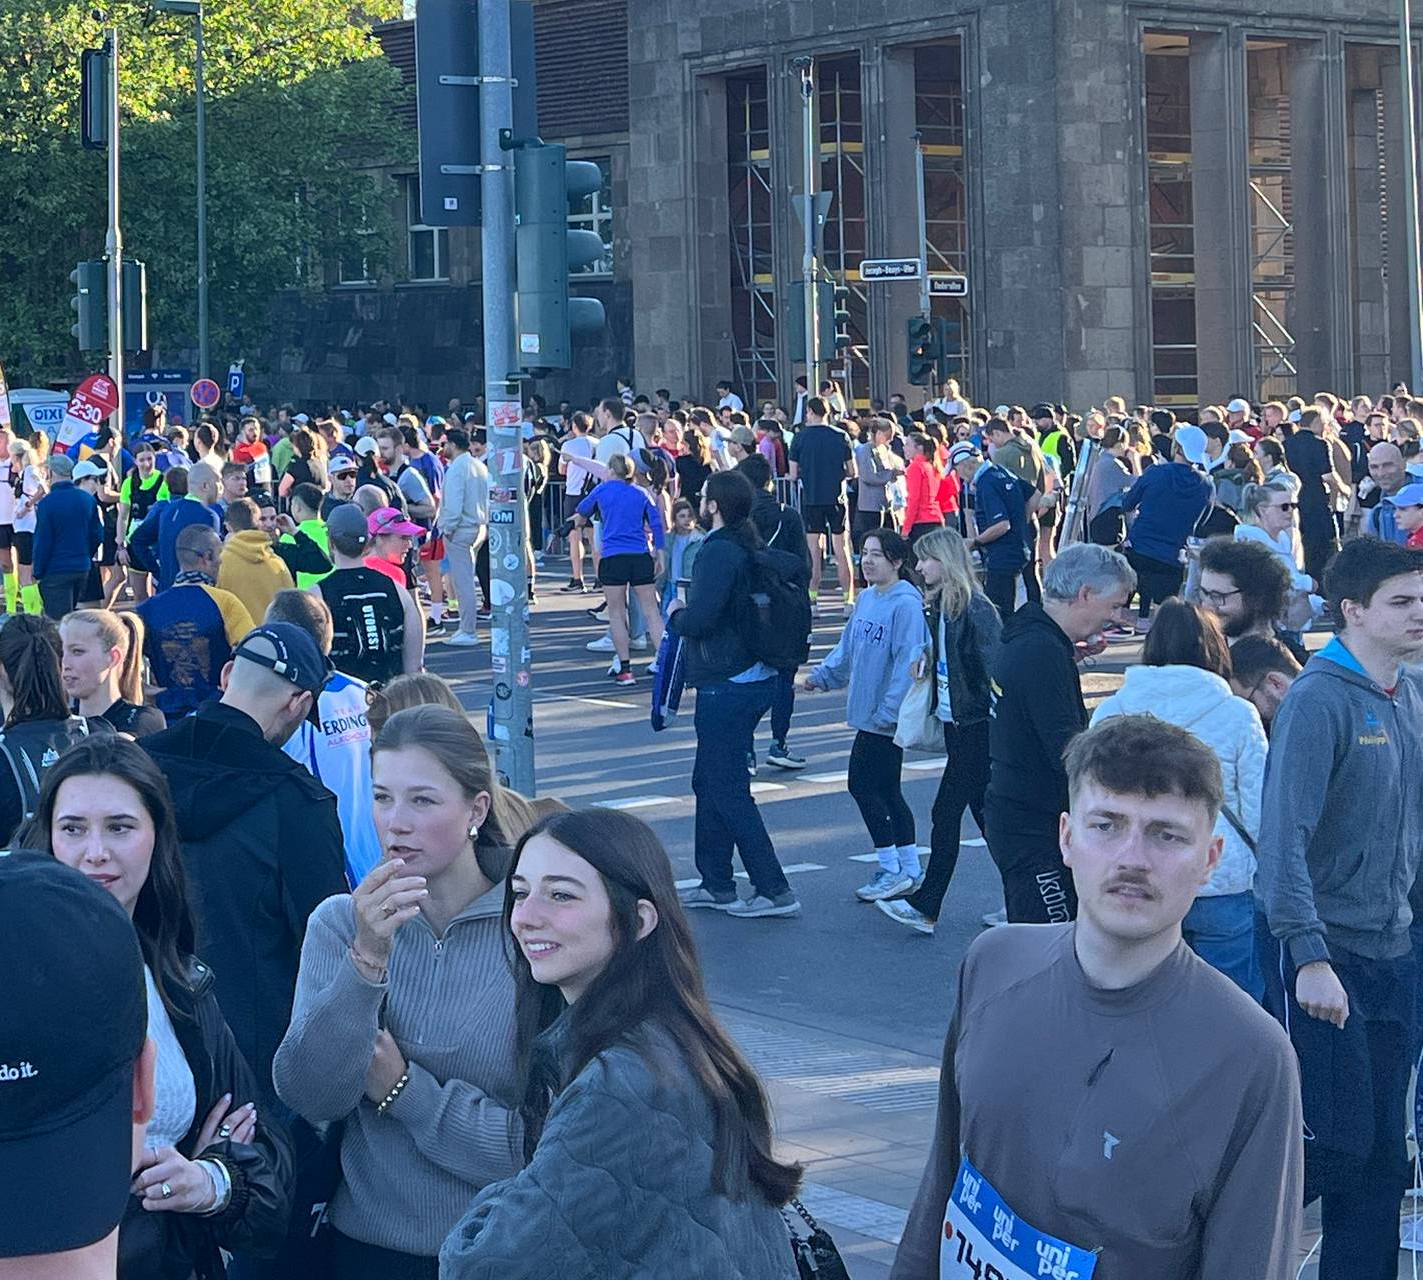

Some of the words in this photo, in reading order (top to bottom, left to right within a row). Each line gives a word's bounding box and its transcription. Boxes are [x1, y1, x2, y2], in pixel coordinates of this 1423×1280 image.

[34, 408, 63, 421] DIXI
[68, 398, 103, 424] 2:30
[361, 604, 380, 651] UTOBEST
[322, 713, 367, 736] ERDING
[19, 1061, 39, 1078] it.
[962, 1169, 982, 1194] uni
[959, 1185, 982, 1215] per
[992, 1205, 1015, 1233] uni
[992, 1226, 1020, 1252] per
[1035, 1239, 1071, 1274] uni
[1037, 1260, 1080, 1280] per
